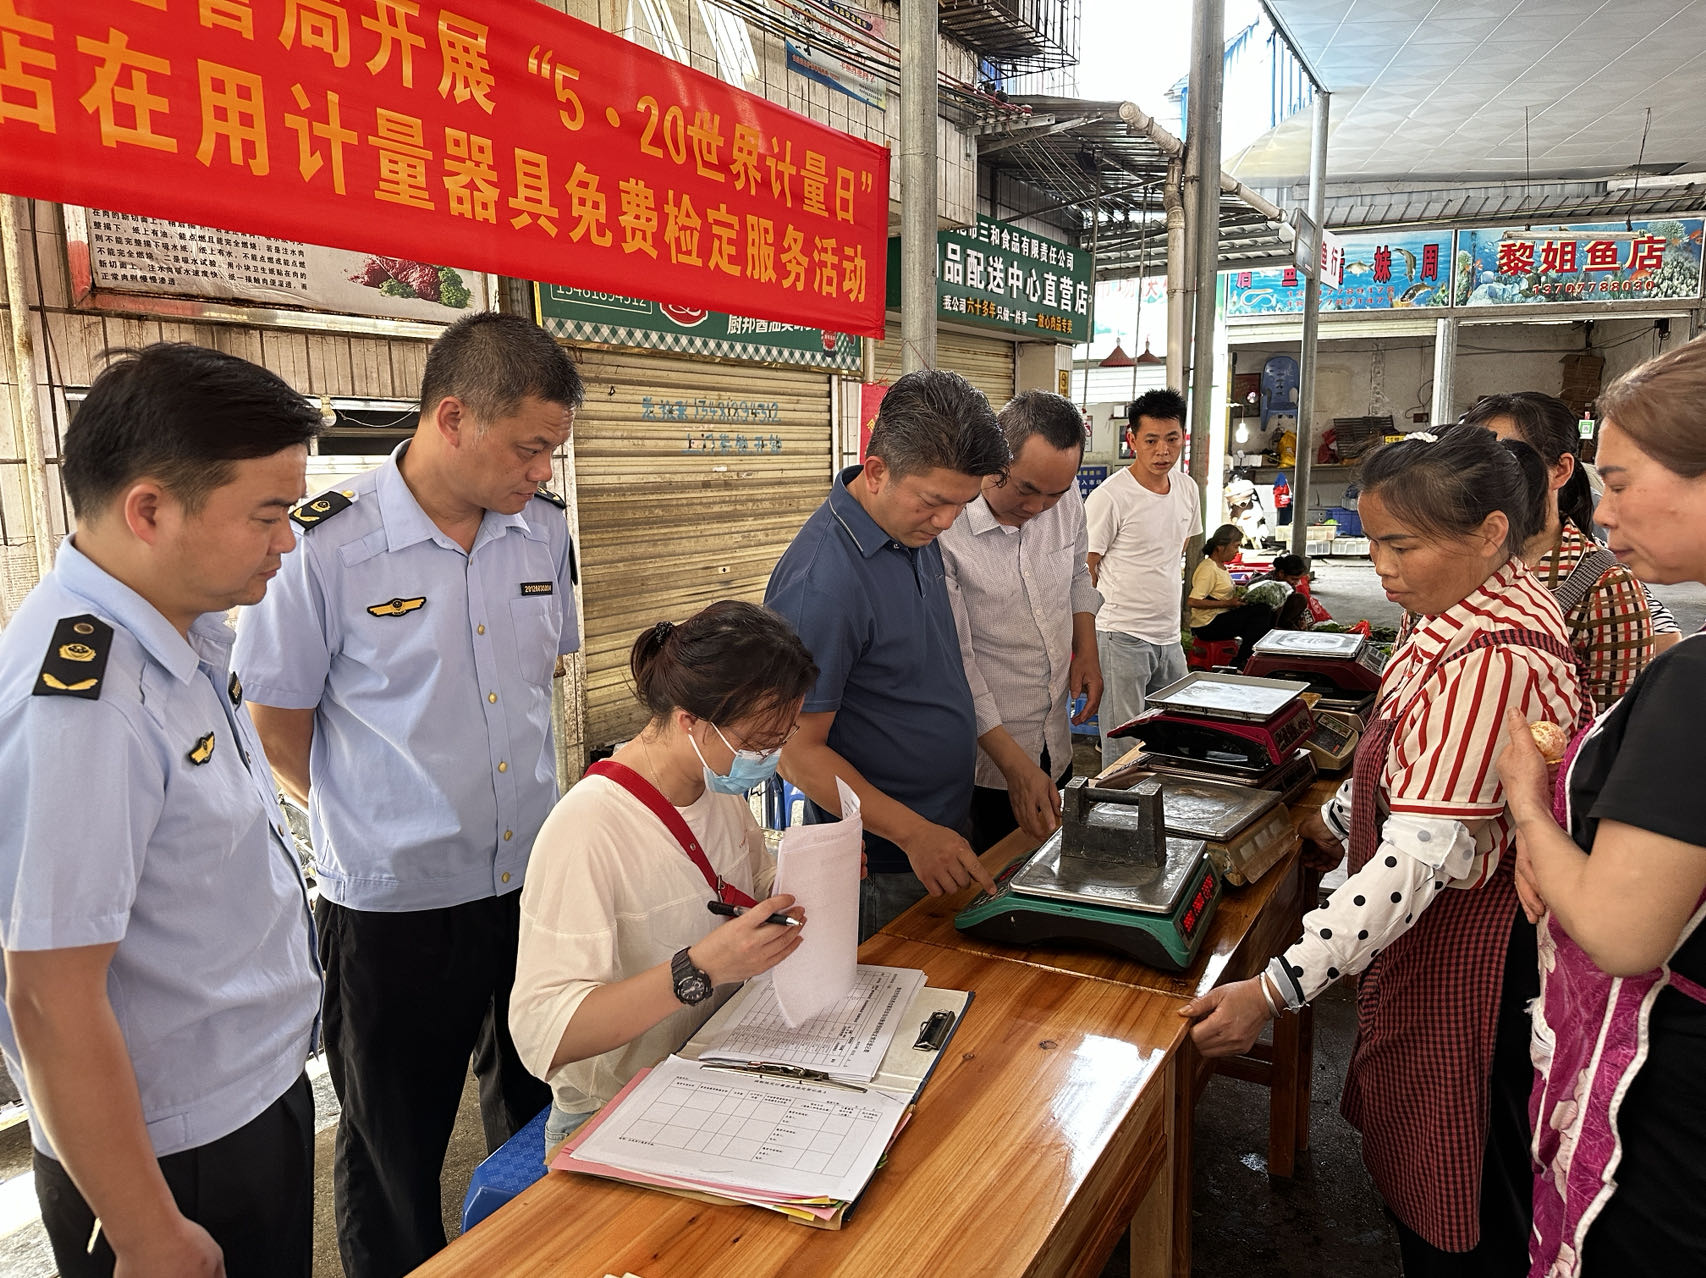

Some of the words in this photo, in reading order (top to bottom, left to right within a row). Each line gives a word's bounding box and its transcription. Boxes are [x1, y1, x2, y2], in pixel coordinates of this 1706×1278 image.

[130, 0, 873, 225] 局开展“5·20世界计量日”
[949, 220, 1074, 272] 市三和食品有限责任公司
[1498, 235, 1667, 276] 黎姐鱼店
[936, 242, 1088, 315] 品配送中心直营店
[1532, 279, 1655, 296] 13707788030
